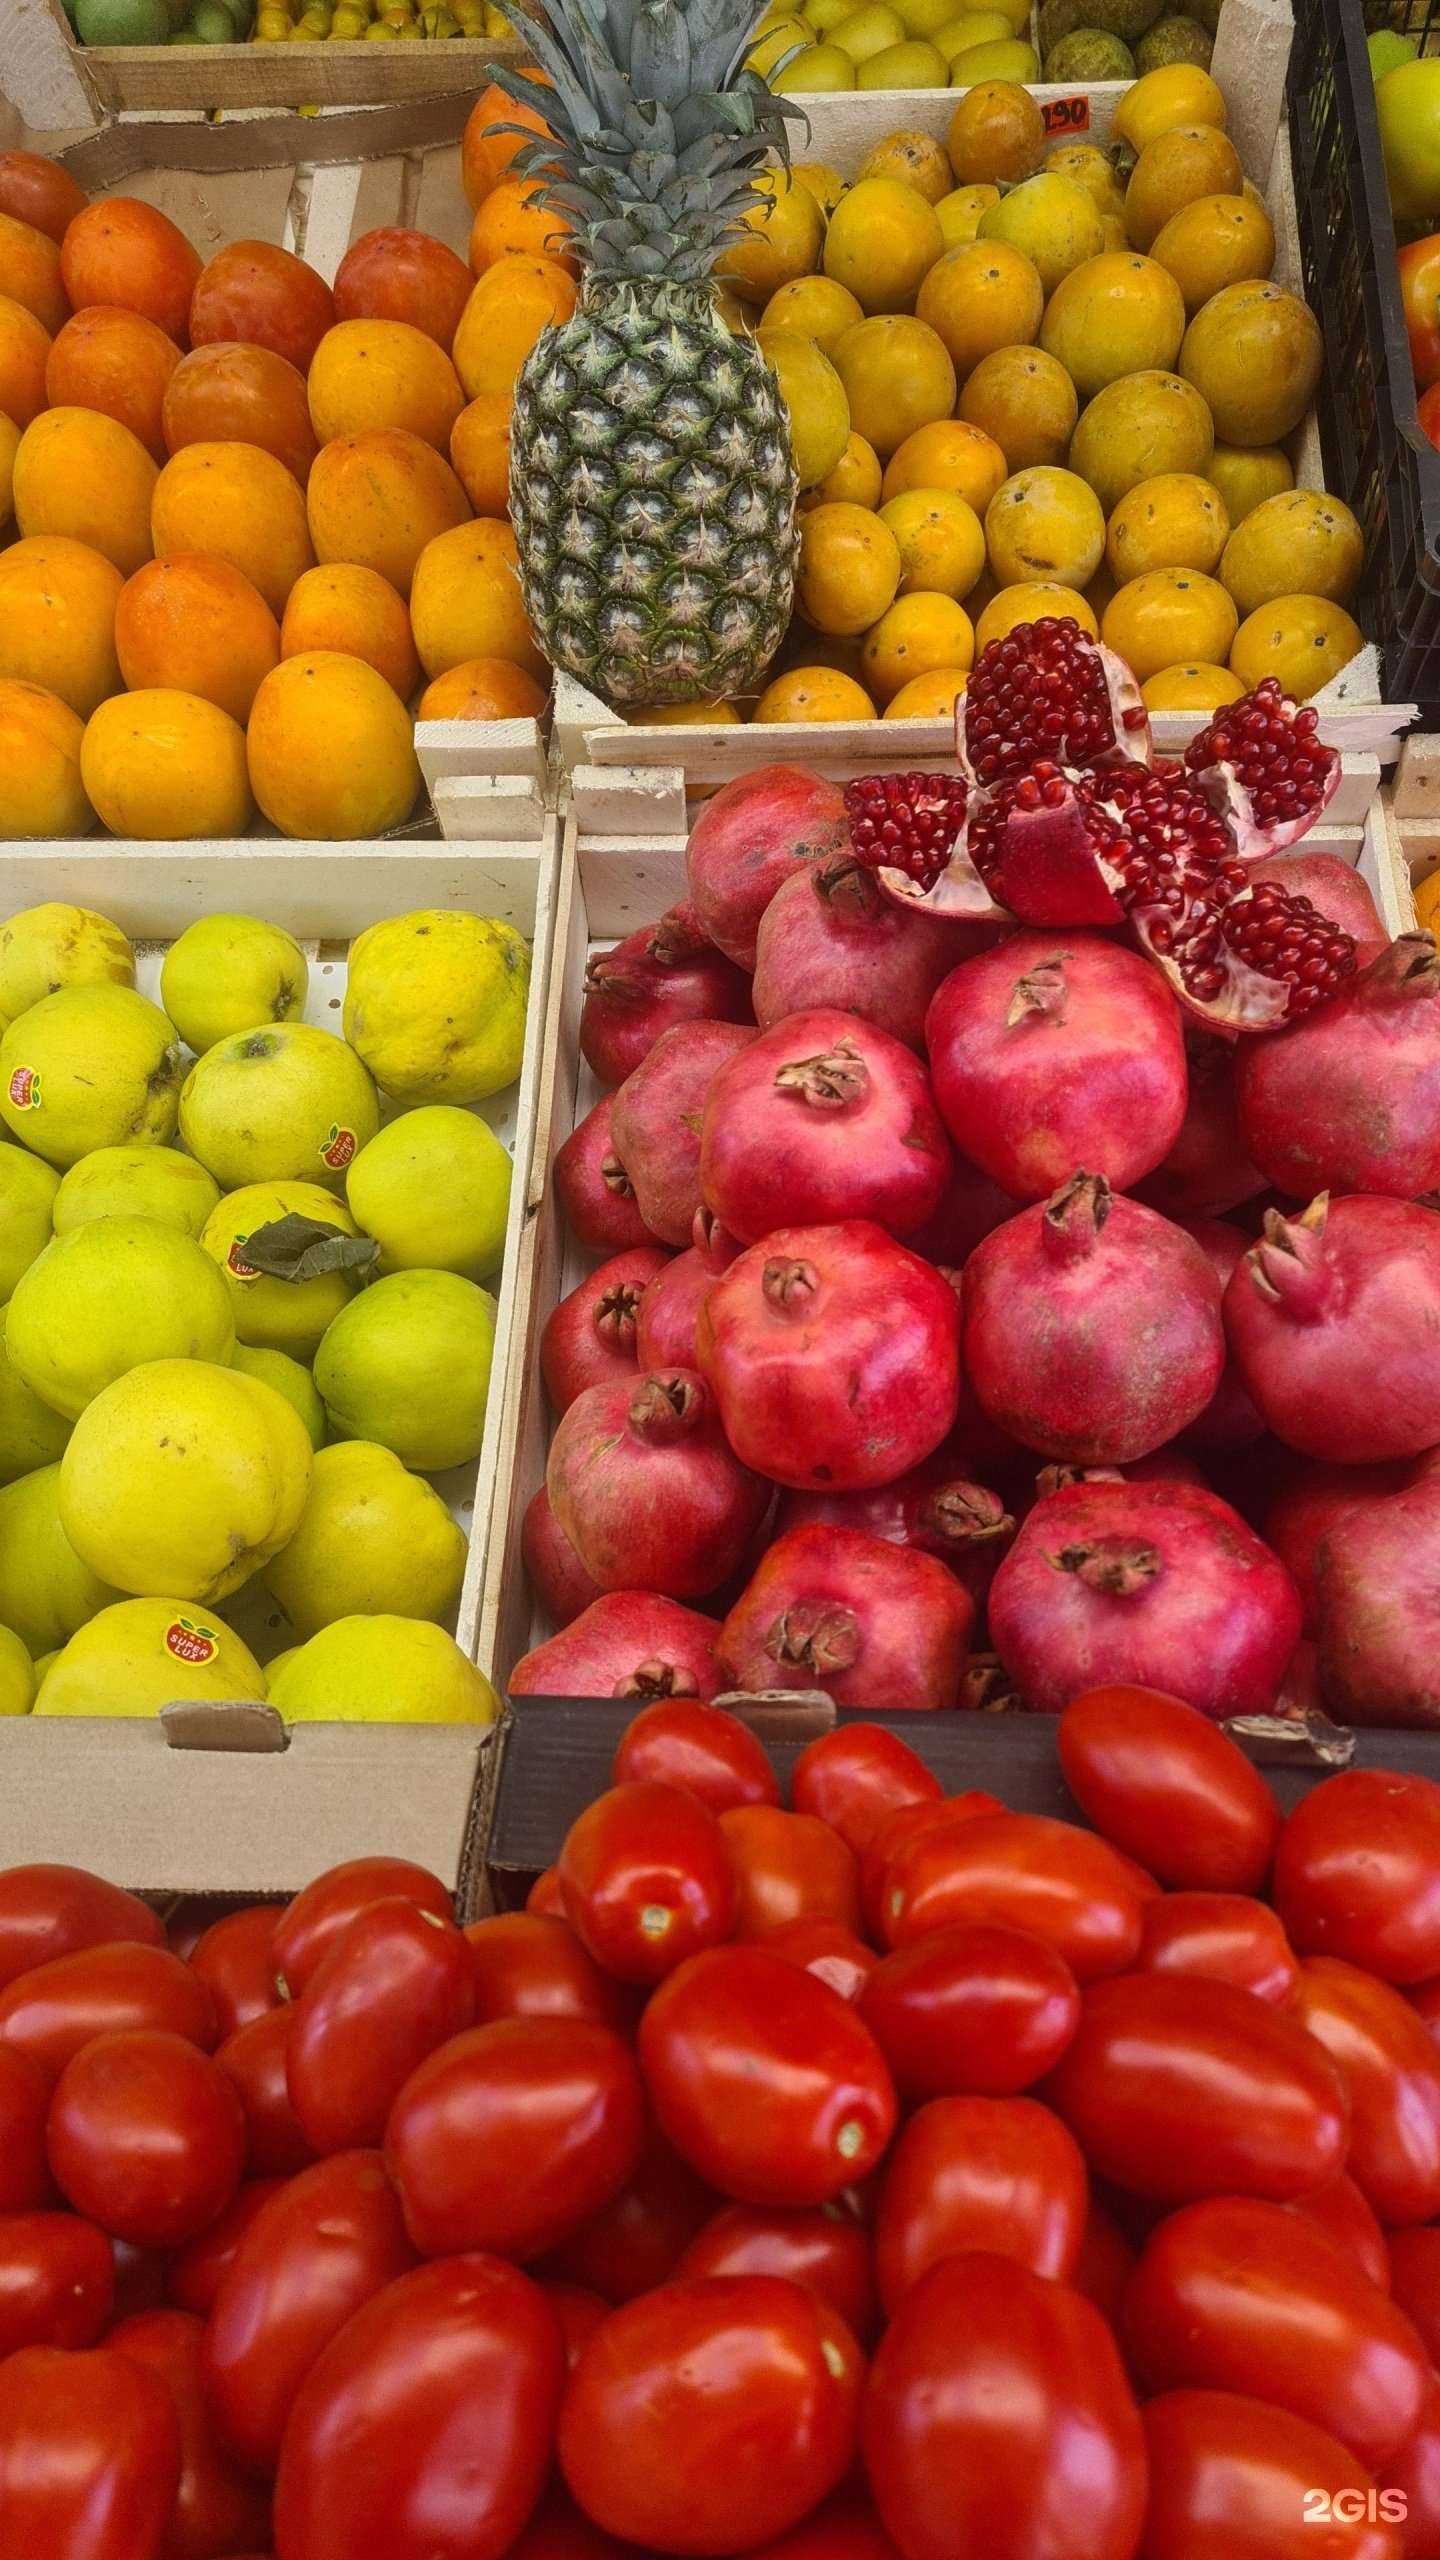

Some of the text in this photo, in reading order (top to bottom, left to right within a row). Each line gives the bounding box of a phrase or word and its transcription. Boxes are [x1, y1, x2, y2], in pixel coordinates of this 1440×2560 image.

[332, 1136, 353, 1164] SUPER
[341, 1144, 353, 1164] LUX
[170, 1634, 209, 1657] SUPER
[174, 1645, 198, 1660] LUX
